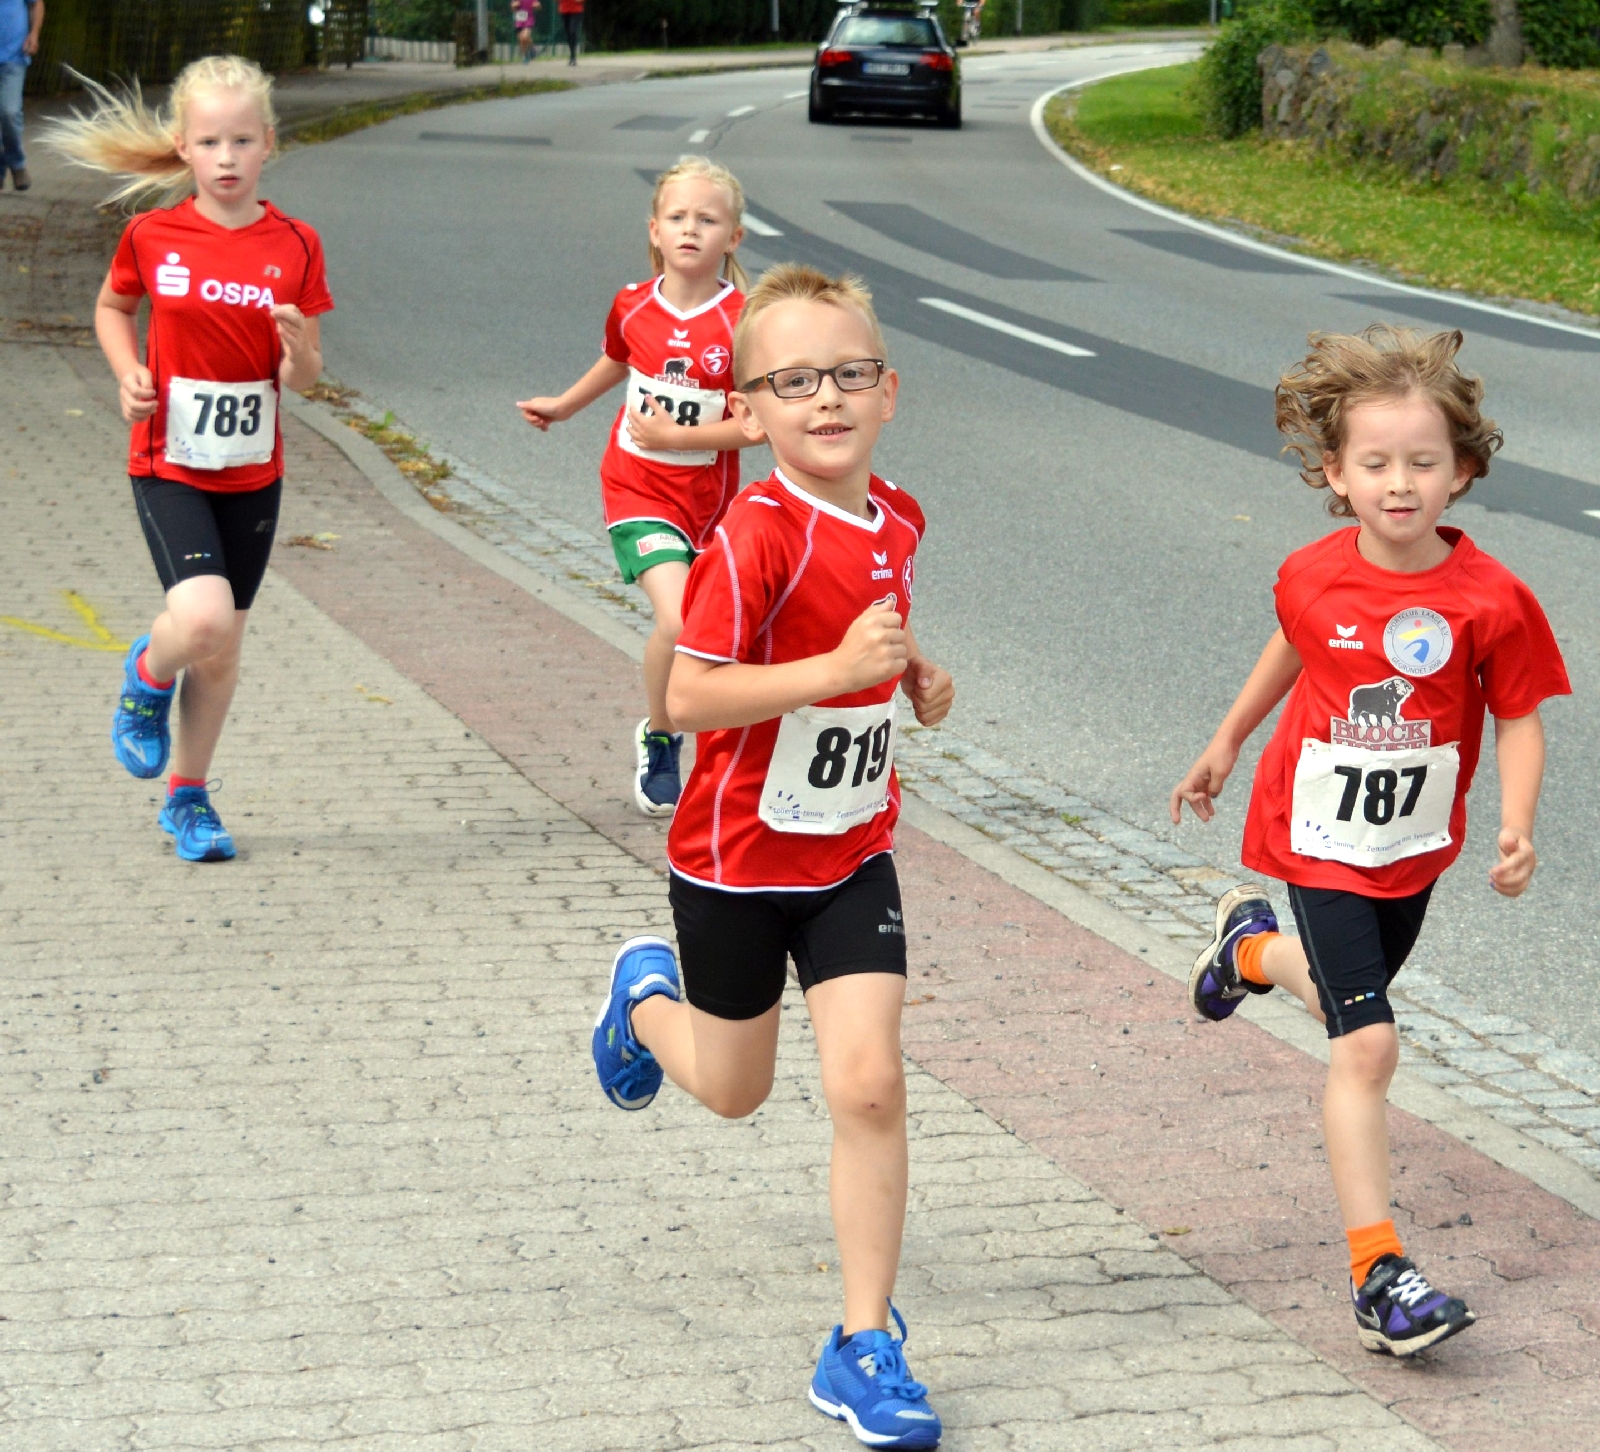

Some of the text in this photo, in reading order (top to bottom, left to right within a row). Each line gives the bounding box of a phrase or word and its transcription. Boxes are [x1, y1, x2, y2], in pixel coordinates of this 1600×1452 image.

[201, 279, 275, 309] OSPA
[194, 392, 262, 438] 783
[871, 567, 893, 581] erima
[1328, 638, 1364, 650] erima
[1332, 718, 1428, 743] BLOCK
[807, 718, 892, 789] 819
[1334, 764, 1428, 826] 787
